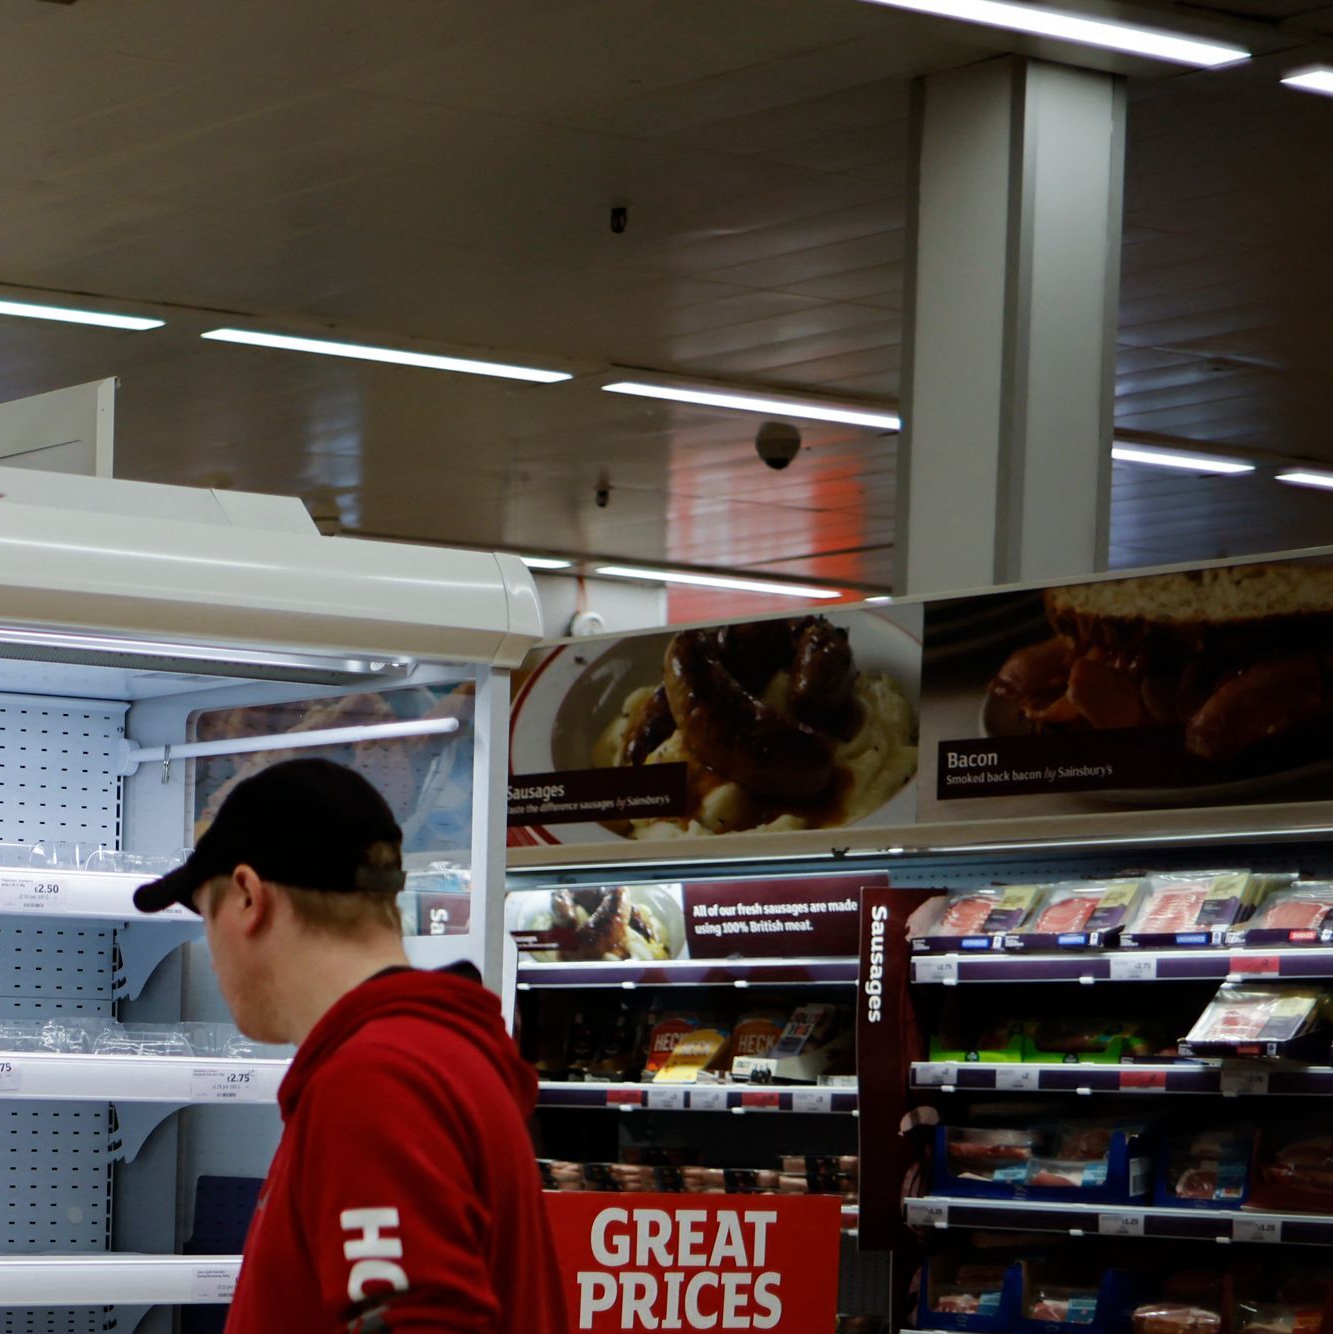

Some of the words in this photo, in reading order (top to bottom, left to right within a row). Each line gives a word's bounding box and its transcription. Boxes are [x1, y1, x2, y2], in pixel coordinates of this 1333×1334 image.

[947, 752, 998, 769] Bacon
[946, 773, 985, 785] Smoked
[986, 771, 1010, 782] back
[1012, 769, 1042, 781] bacon
[1056, 764, 1113, 778] Sainsbury's
[507, 784, 566, 801] Sausages
[34, 884, 59, 894] £2.50
[693, 904, 707, 917] All
[708, 904, 719, 917] of
[719, 906, 736, 916] our
[737, 902, 763, 916] fresh
[763, 902, 809, 917] sausages
[809, 903, 827, 913] are
[828, 899, 858, 912] made
[695, 923, 722, 937] using
[721, 922, 749, 934] 100%
[749, 920, 784, 933] British
[785, 919, 814, 932] meat.
[865, 905, 888, 1023] Sausages
[227, 1073, 250, 1083] £2.75
[590, 1207, 778, 1267] GREAT
[576, 1271, 783, 1330] PRICES
